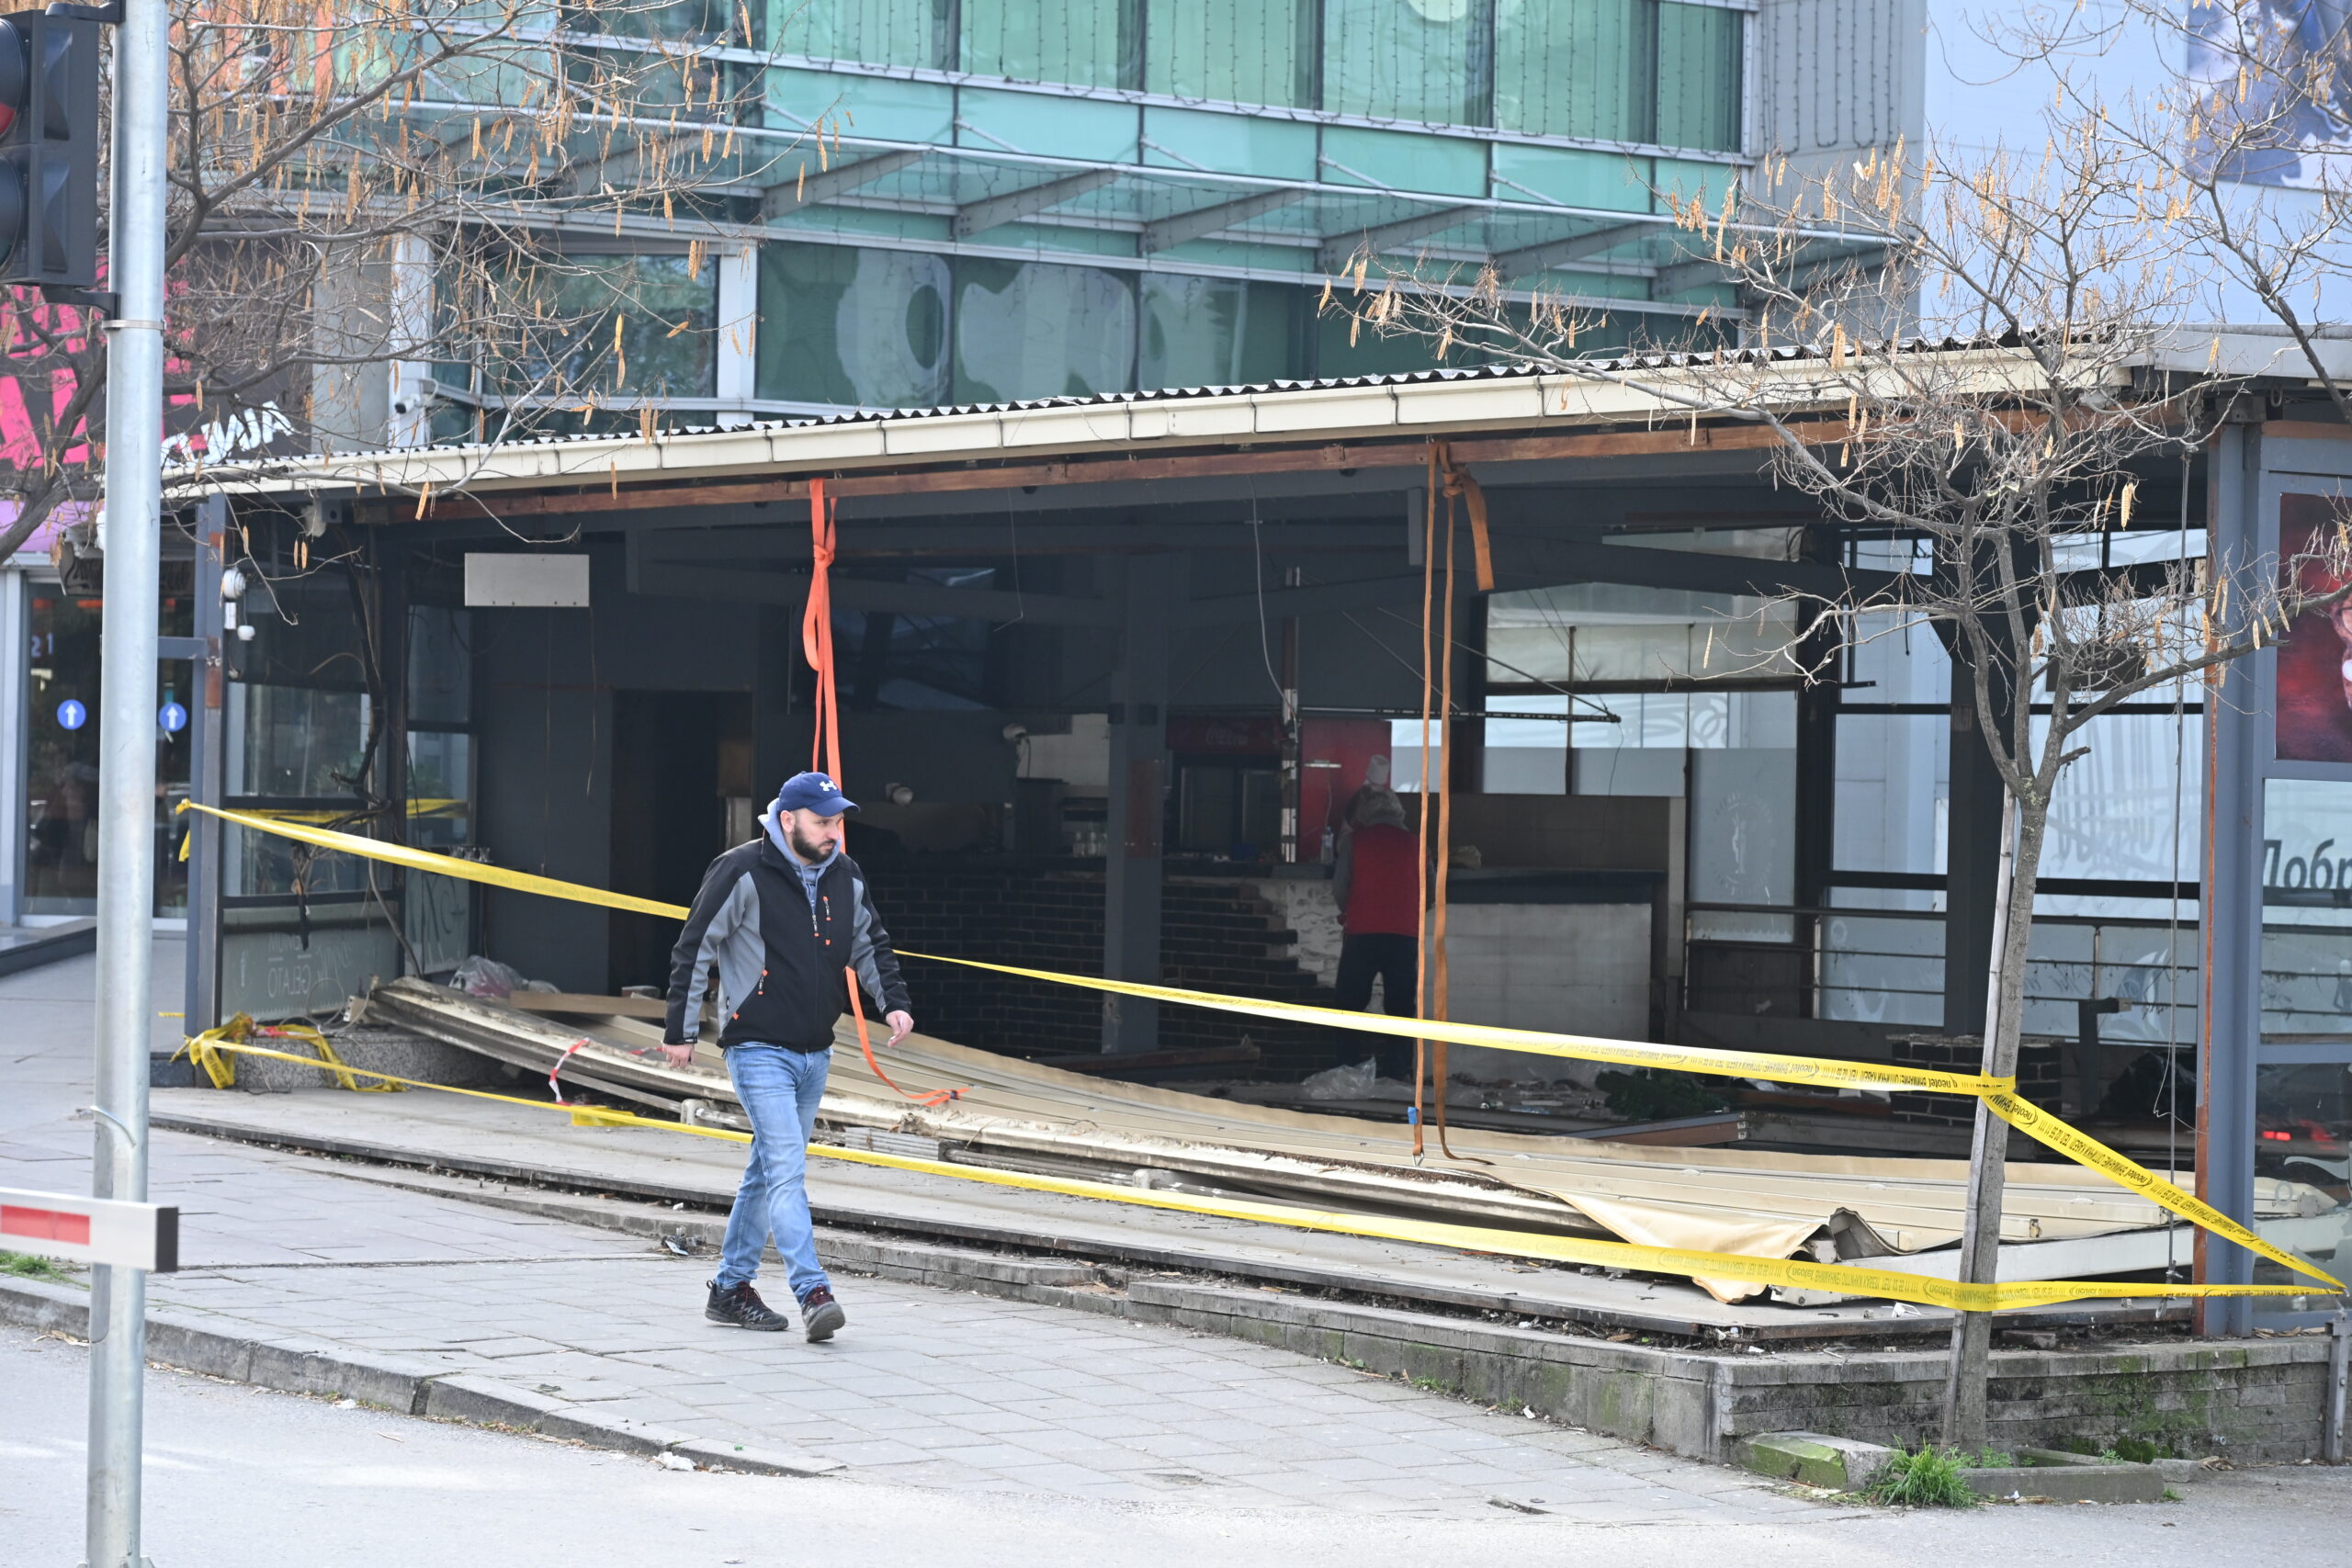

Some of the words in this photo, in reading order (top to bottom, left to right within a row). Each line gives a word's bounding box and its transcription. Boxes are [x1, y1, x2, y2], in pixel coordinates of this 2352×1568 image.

[1928, 1077, 1951, 1089] neotel
[2009, 1102, 2032, 1120] neotel
[2124, 1169, 2148, 1186] neotel
